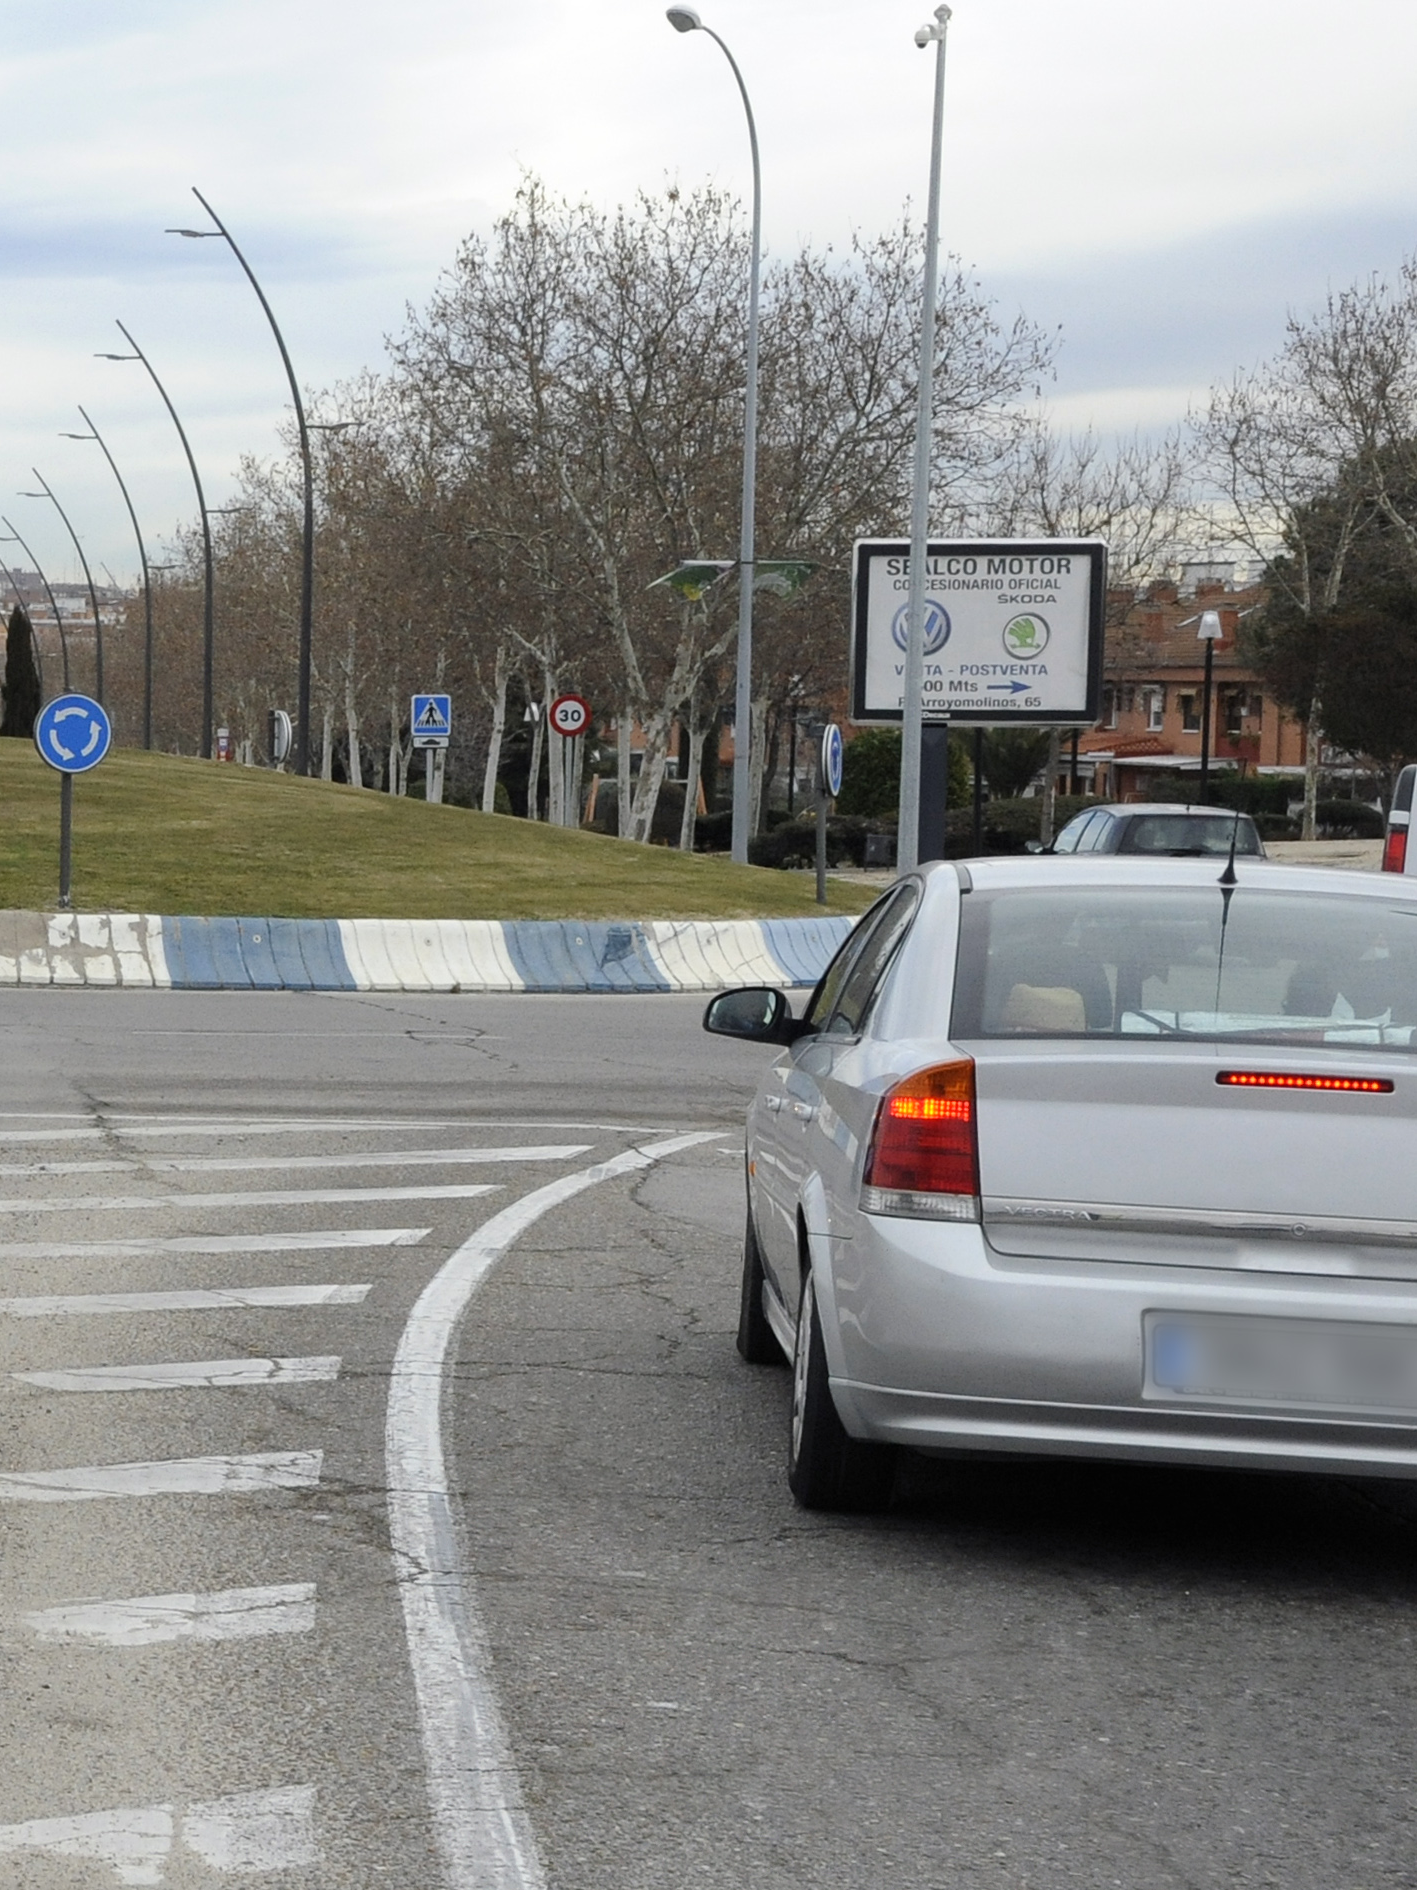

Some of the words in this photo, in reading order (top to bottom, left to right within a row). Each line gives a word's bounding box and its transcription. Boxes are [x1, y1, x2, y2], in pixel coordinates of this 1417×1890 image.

[987, 557, 1071, 575] MOTOR
[893, 578, 1003, 591] COESIONARIO
[1008, 578, 1061, 590] OFICIAL
[894, 664, 942, 676] VTA
[960, 664, 1048, 676] POSTVENTA
[949, 680, 978, 692] Mts
[1024, 697, 1041, 707] 65
[559, 709, 581, 722] 30
